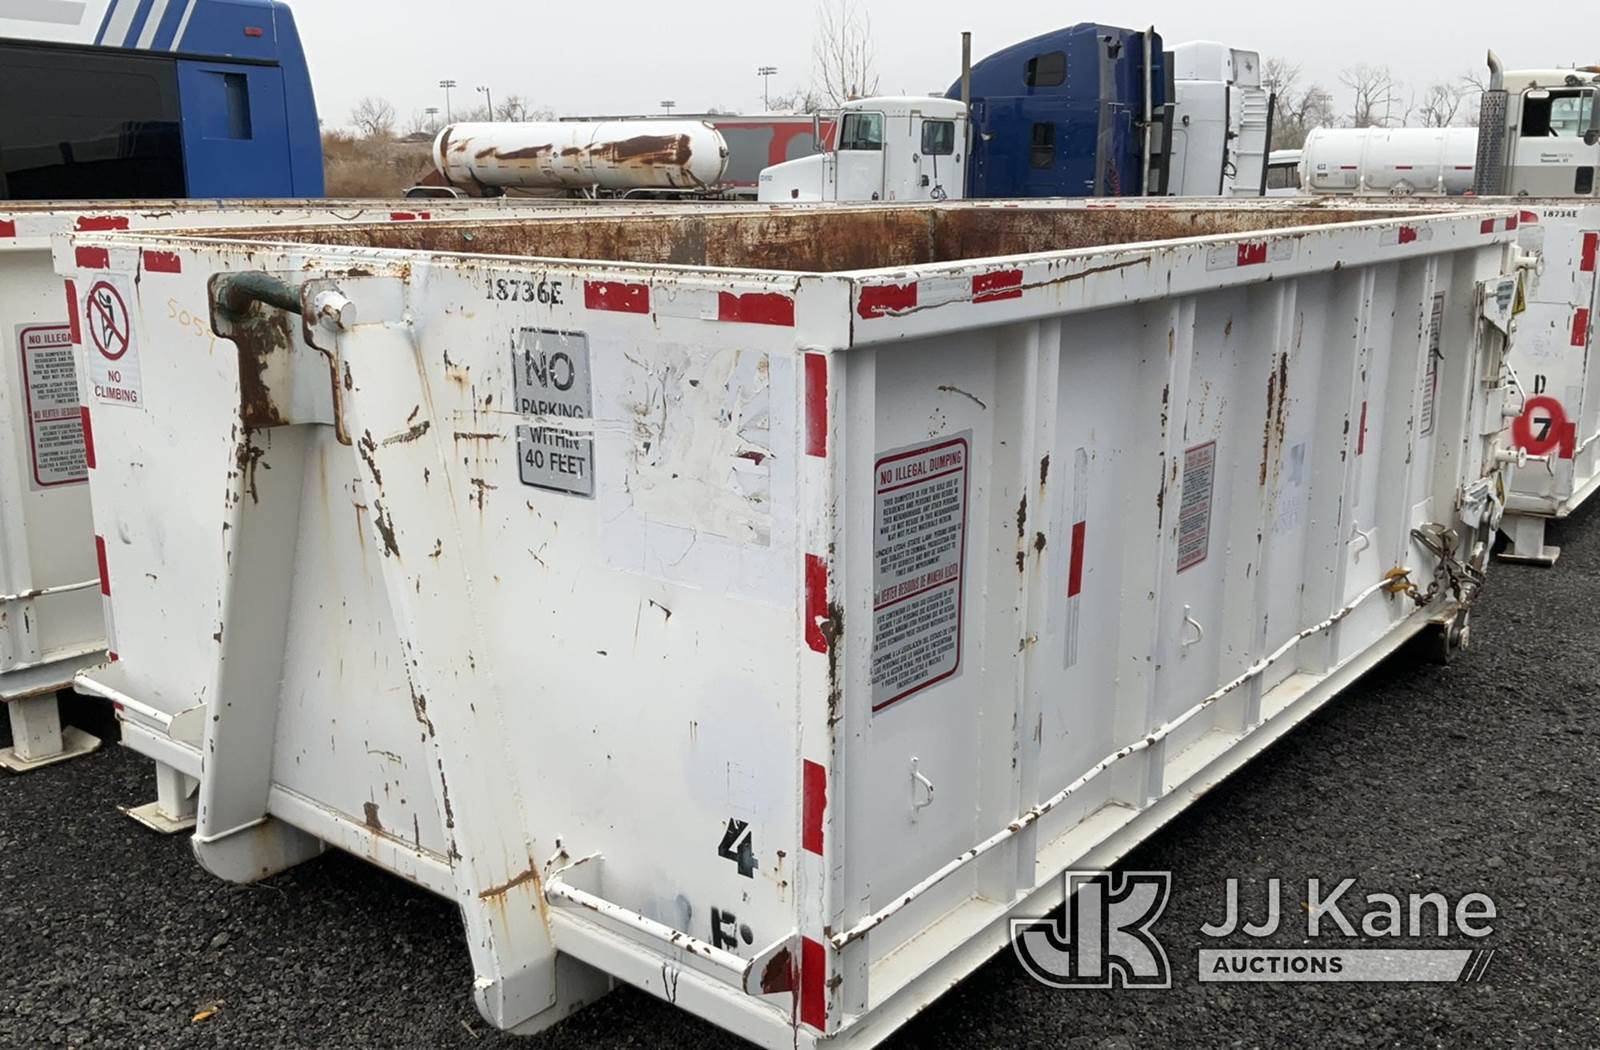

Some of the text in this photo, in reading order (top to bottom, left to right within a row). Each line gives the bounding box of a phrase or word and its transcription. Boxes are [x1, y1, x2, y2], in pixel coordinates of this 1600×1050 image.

[1543, 210, 1577, 218] 18734E
[29, 335, 41, 344] NO
[108, 370, 121, 383] NO
[525, 350, 575, 391] NO
[94, 385, 138, 404] CLIMBING
[522, 398, 584, 420] PARKING
[529, 426, 580, 450] WITHIN
[1533, 417, 1552, 442] 7
[525, 448, 586, 477] 40 FEET
[880, 450, 961, 486] NO ILLEGAL DUMPING
[718, 818, 759, 879] 4
